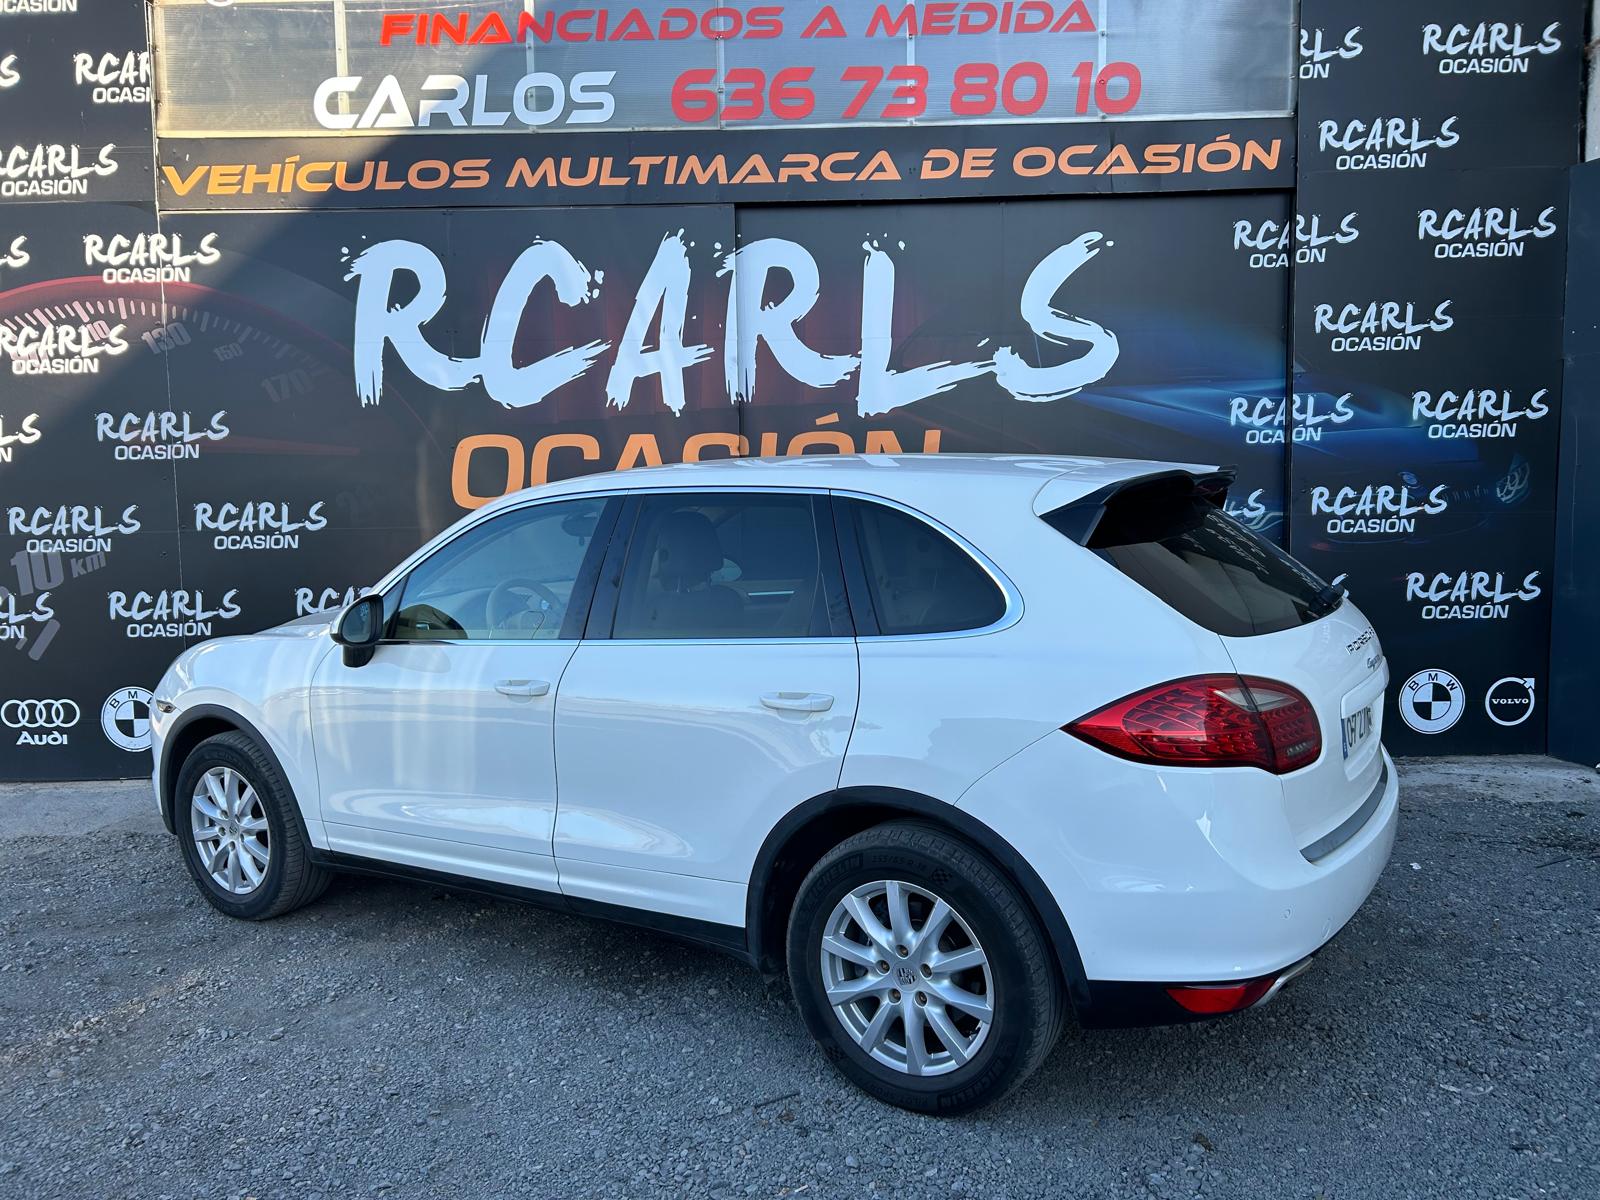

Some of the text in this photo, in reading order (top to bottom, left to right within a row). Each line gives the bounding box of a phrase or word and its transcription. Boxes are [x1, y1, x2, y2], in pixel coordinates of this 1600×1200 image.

[379, 0, 1097, 46] FINANCIADOS A MEDIDA
[1422, 21, 1562, 54] RCARLS
[1438, 56, 1528, 74] OCASIÓN
[93, 86, 151, 103] OCASI
[312, 61, 1142, 129] CARLOS 636 73 80 10
[1318, 116, 1460, 152] RCARLS
[0, 143, 118, 178] CARLS
[161, 133, 1282, 196] VEHÍCULOS MULTIMARCA DE OCASIÓN
[1335, 150, 1426, 170] OCASIÓN
[1, 176, 87, 196] OCASIÓN
[1417, 205, 1557, 241] RCARLS
[83, 232, 222, 266] RCARLS
[1434, 239, 1524, 258] OCASIÓN
[103, 263, 190, 284] OCASIÓN
[340, 228, 1120, 418] RCARLS
[1313, 300, 1454, 334] RCARLS
[0, 324, 129, 357] RCARLS
[1331, 333, 1421, 351] OCASIÓN
[12, 355, 98, 375] OCASIÓN
[1412, 388, 1549, 421] RCARLS
[94, 410, 230, 442] RCARLS
[1428, 419, 1517, 438] OCASIÓN
[115, 442, 199, 460] OCASIÓN
[1311, 484, 1448, 516] RCARLS
[6, 504, 141, 537] RCARLS
[193, 501, 328, 532] RCARLS
[1326, 515, 1415, 533] OCASIÓN
[26, 535, 111, 552] OCASIÓN
[214, 531, 299, 550] OCASIÓN
[10, 549, 106, 596] 10 km
[1405, 570, 1541, 603] RCARLS
[108, 589, 241, 620] RCARLS
[1421, 601, 1509, 620] OCASIÓN
[126, 619, 212, 638] OCASIÓN
[1408, 672, 1457, 692] BMW
[1491, 697, 1529, 705] VOLVO
[16, 730, 68, 745] Audi
